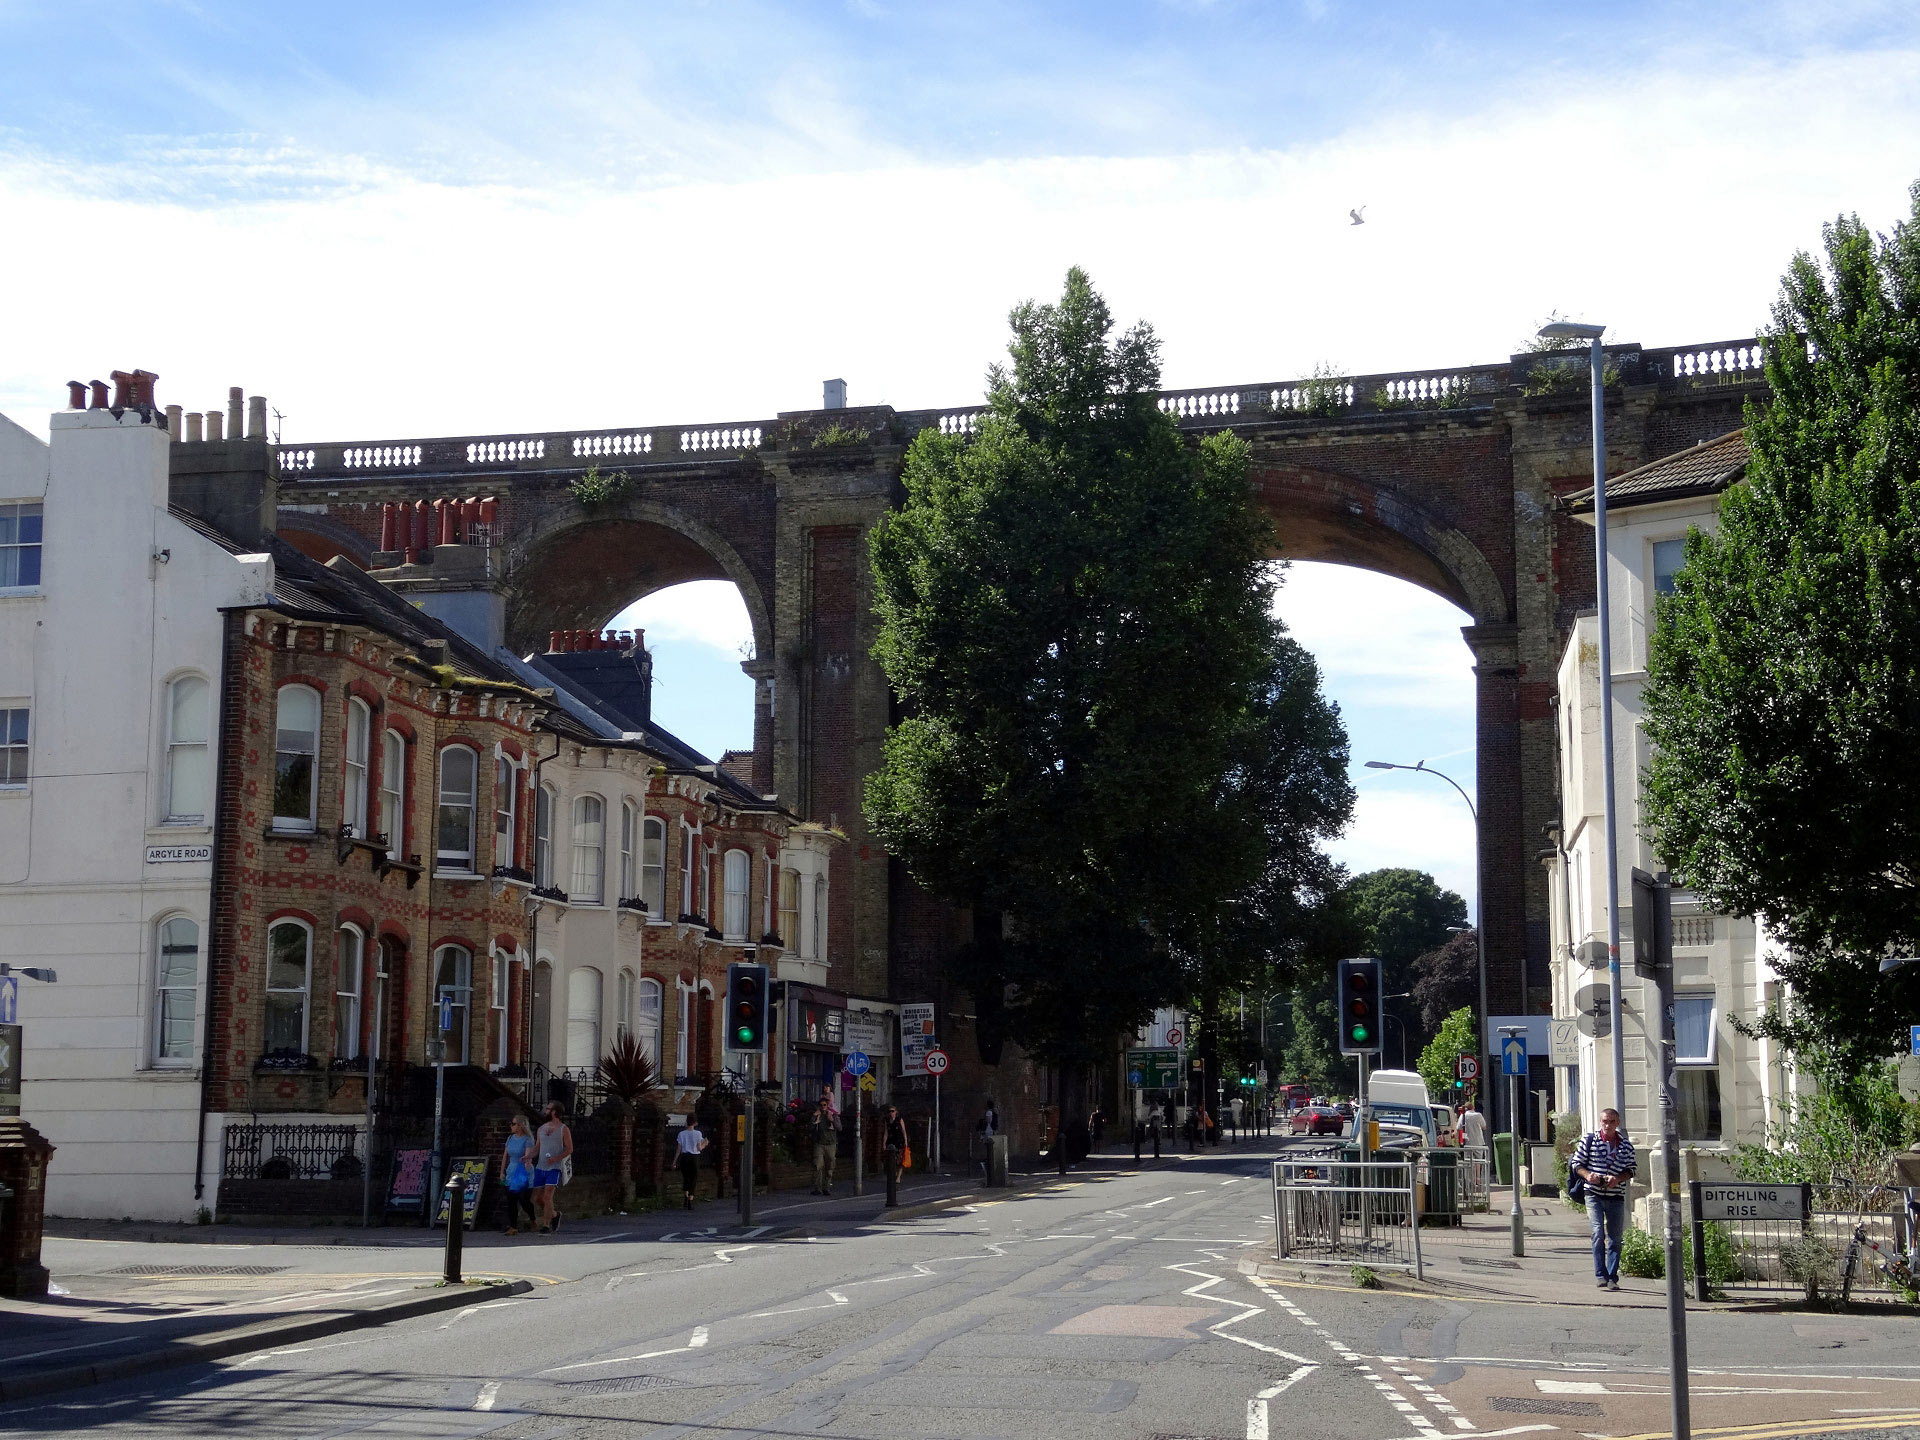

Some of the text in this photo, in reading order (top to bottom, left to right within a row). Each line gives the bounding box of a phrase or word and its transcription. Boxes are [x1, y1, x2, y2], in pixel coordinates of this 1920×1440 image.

[149, 849, 209, 859] ARGYLE ROAD
[929, 1057, 946, 1068] 30
[1461, 1062, 1476, 1073] 30
[1705, 1190, 1777, 1201] DITCHLING
[1727, 1205, 1757, 1216] RISE
